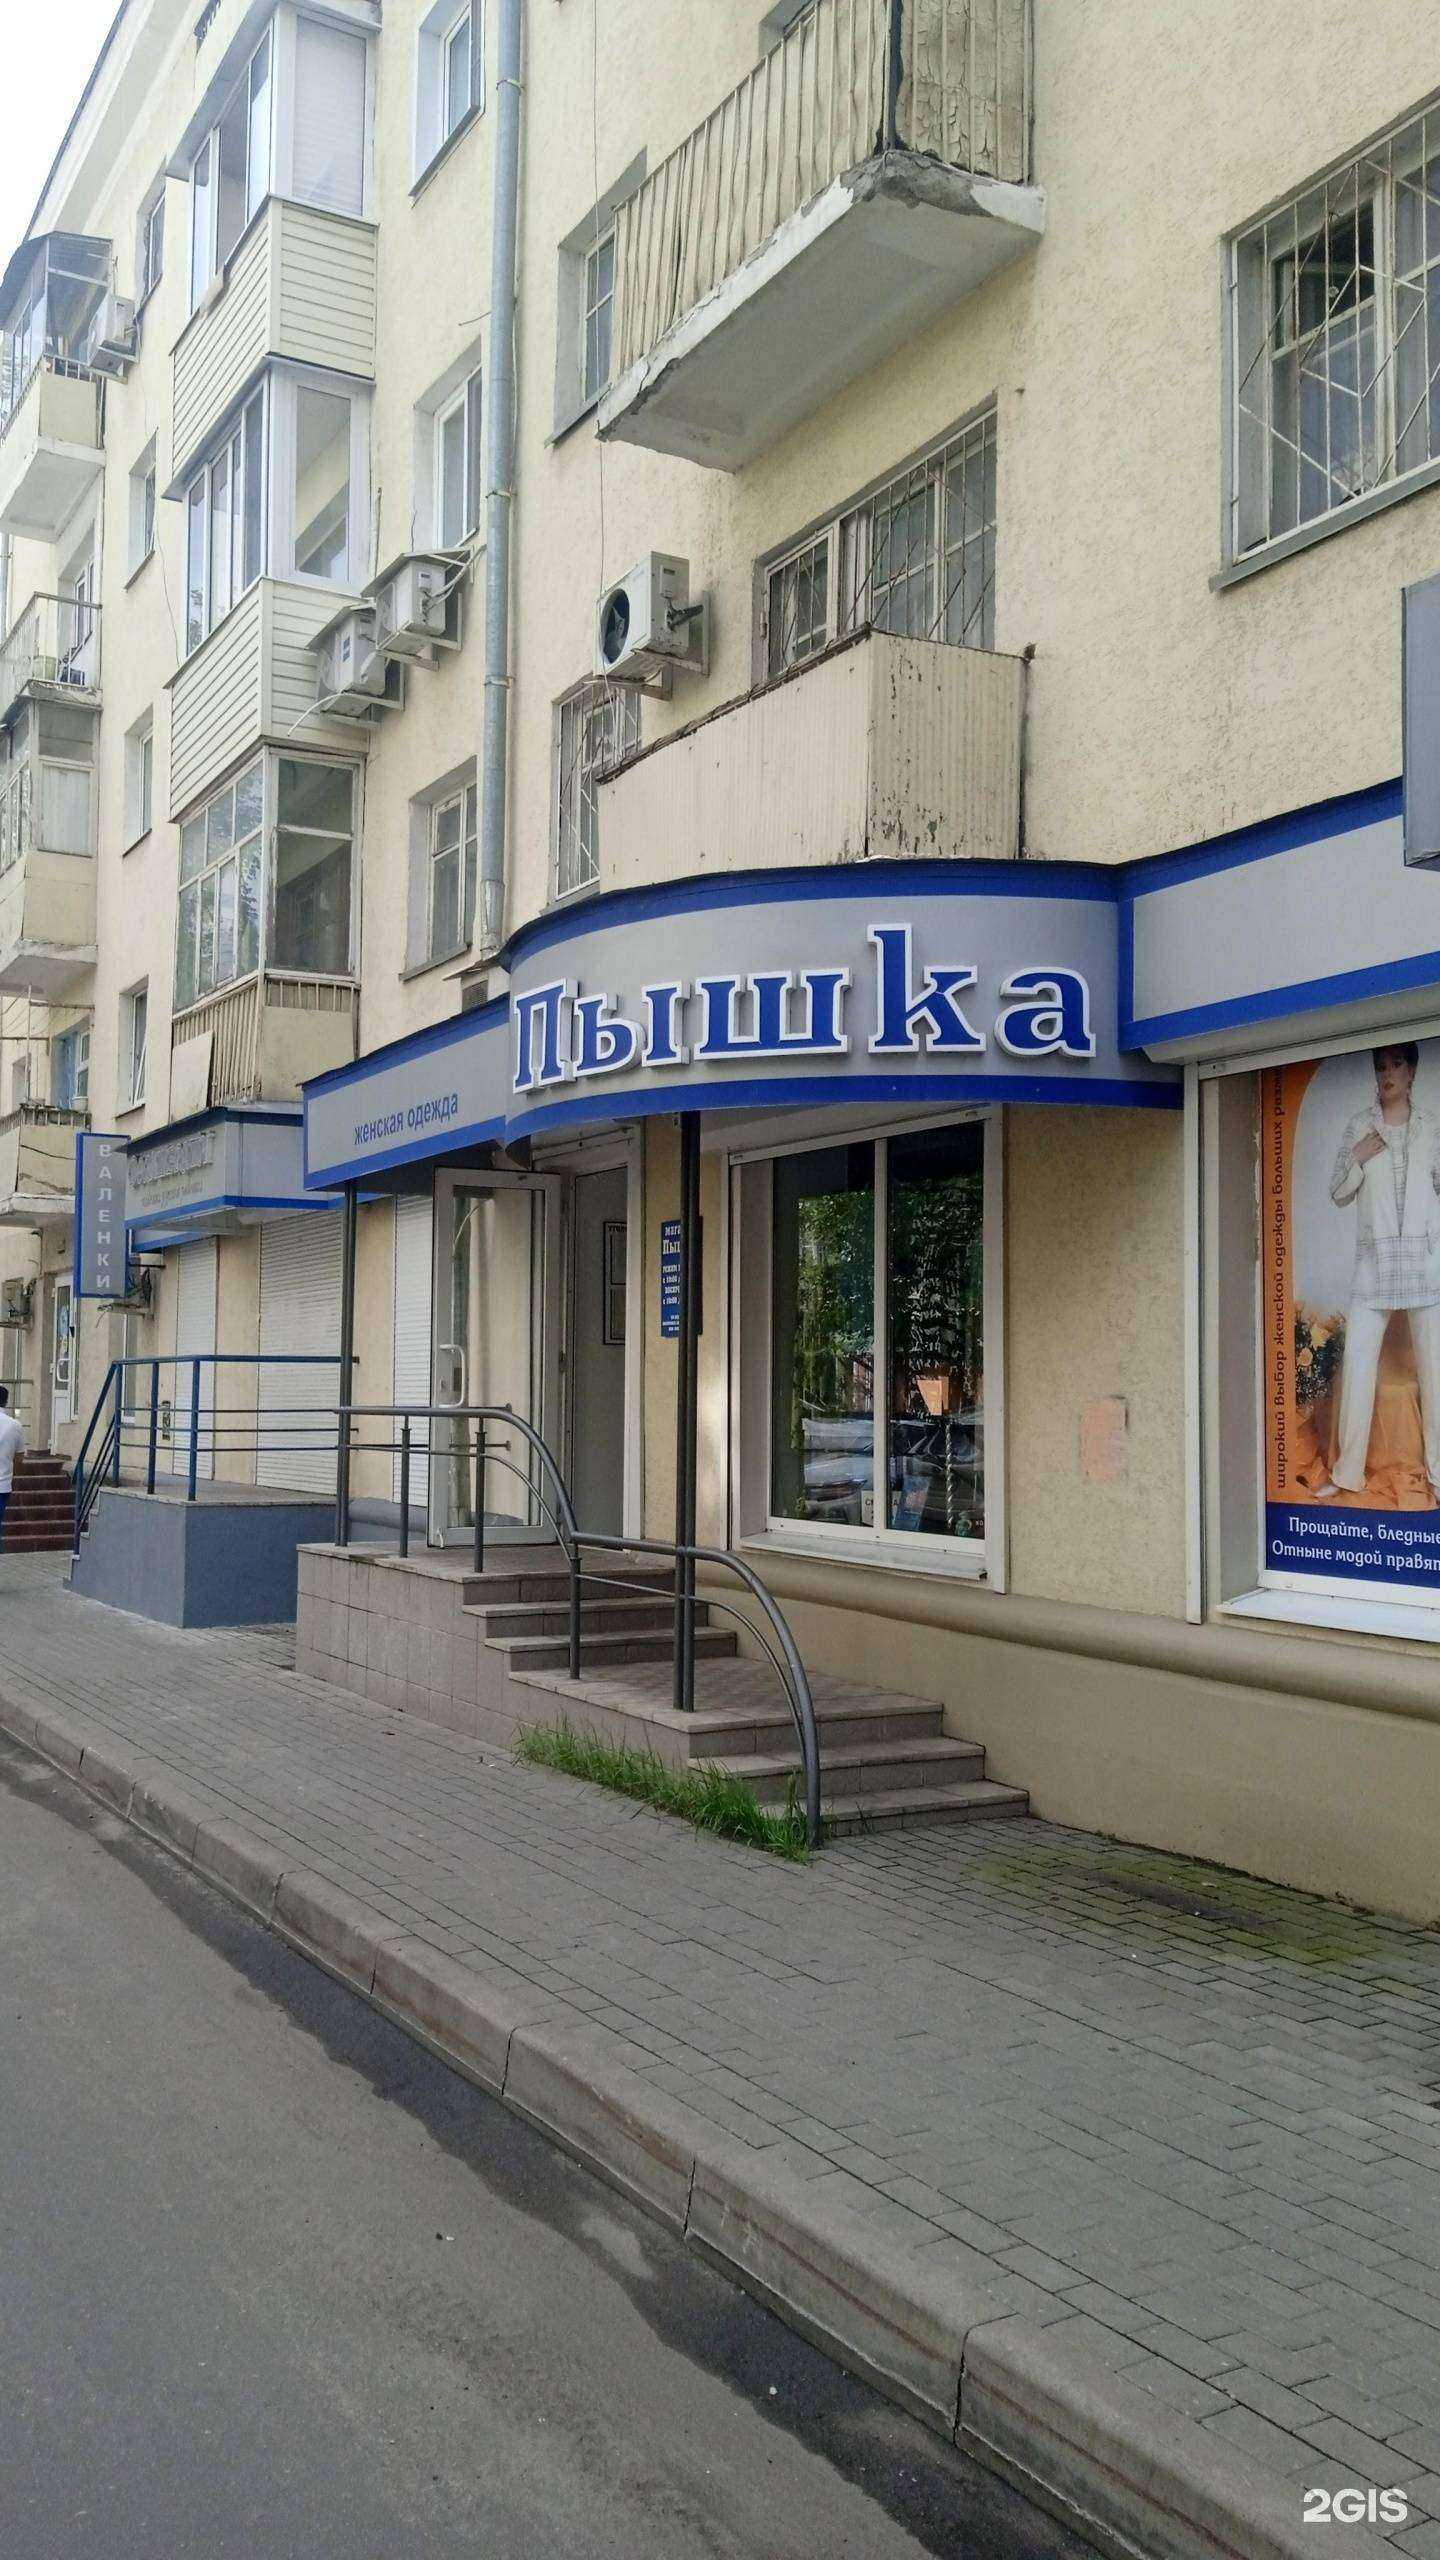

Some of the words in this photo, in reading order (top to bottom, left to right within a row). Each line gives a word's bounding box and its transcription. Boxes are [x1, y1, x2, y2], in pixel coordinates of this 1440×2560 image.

[513, 923, 1096, 1093] Пышка
[354, 1112, 404, 1145] женская
[407, 1093, 458, 1131] одежда
[1272, 1122, 1283, 1195] больших
[97, 1144, 112, 1288] ВАЛЕНКИ
[1273, 1199, 1286, 1267] одежды
[1273, 1274, 1284, 1345] женской
[1274, 1351, 1287, 1406] выбор
[1275, 1411, 1288, 1489] широкий
[1272, 1540, 1332, 1560] Отныне
[1336, 1549, 1382, 1567] модой
[1289, 1517, 1373, 1540] Прощайте,
